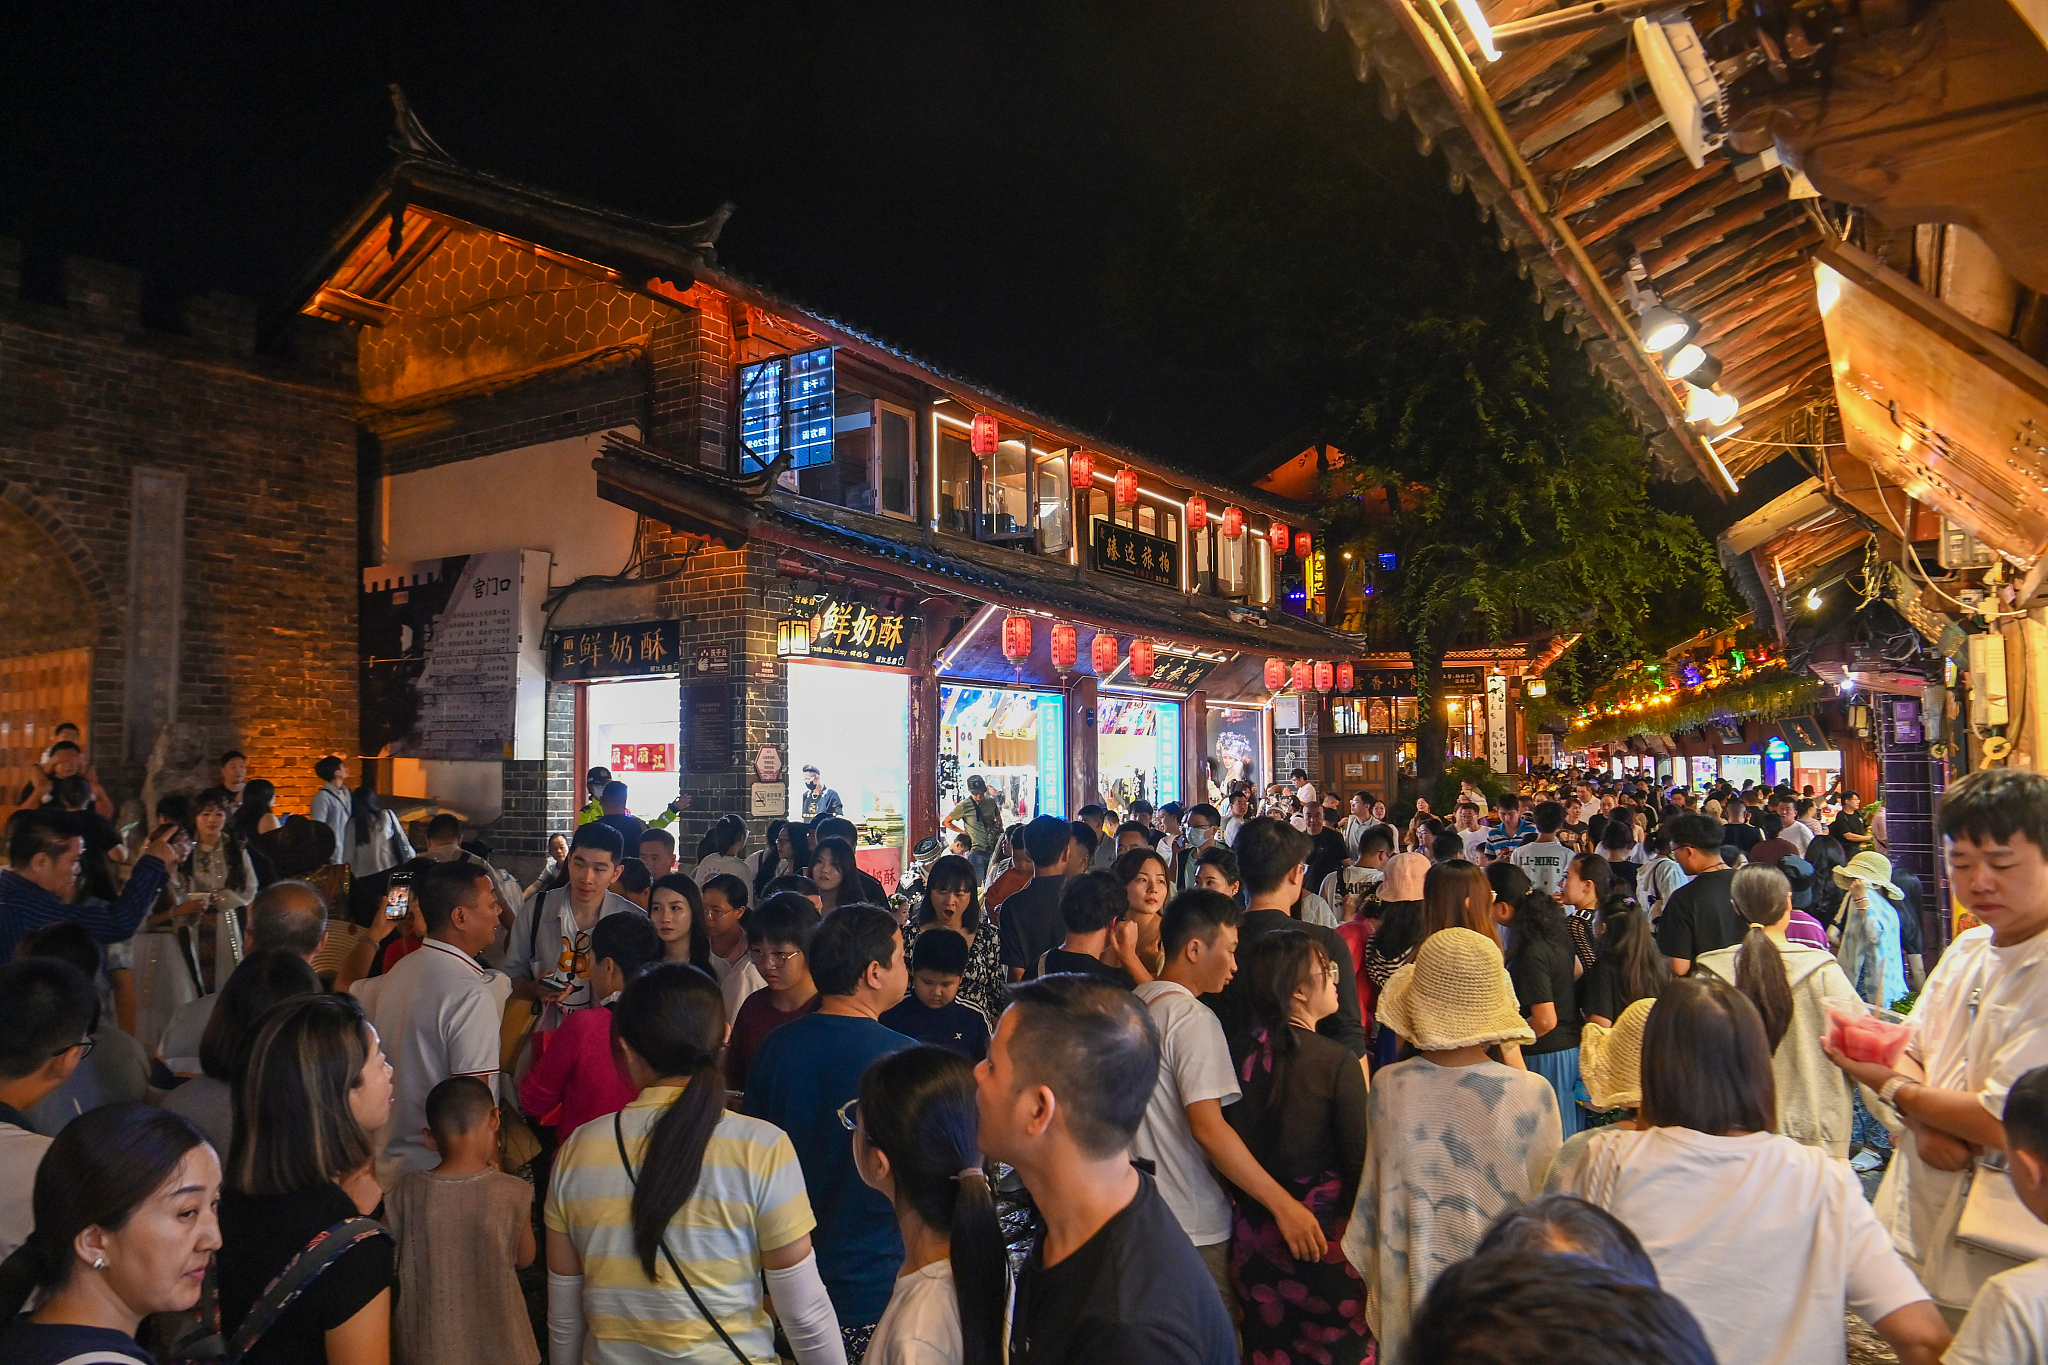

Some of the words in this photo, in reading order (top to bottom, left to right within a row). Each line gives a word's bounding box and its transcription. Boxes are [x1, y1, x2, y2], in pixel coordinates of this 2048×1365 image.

[820, 601, 904, 651] 鲜奶酥
[563, 635, 575, 668] 丽江
[579, 628, 668, 667] 鲜奶酥
[612, 747, 635, 770] 丽江
[638, 747, 665, 770] 丽江
[1520, 856, 1560, 866] LI-NING
[867, 868, 896, 886] 奶酥
